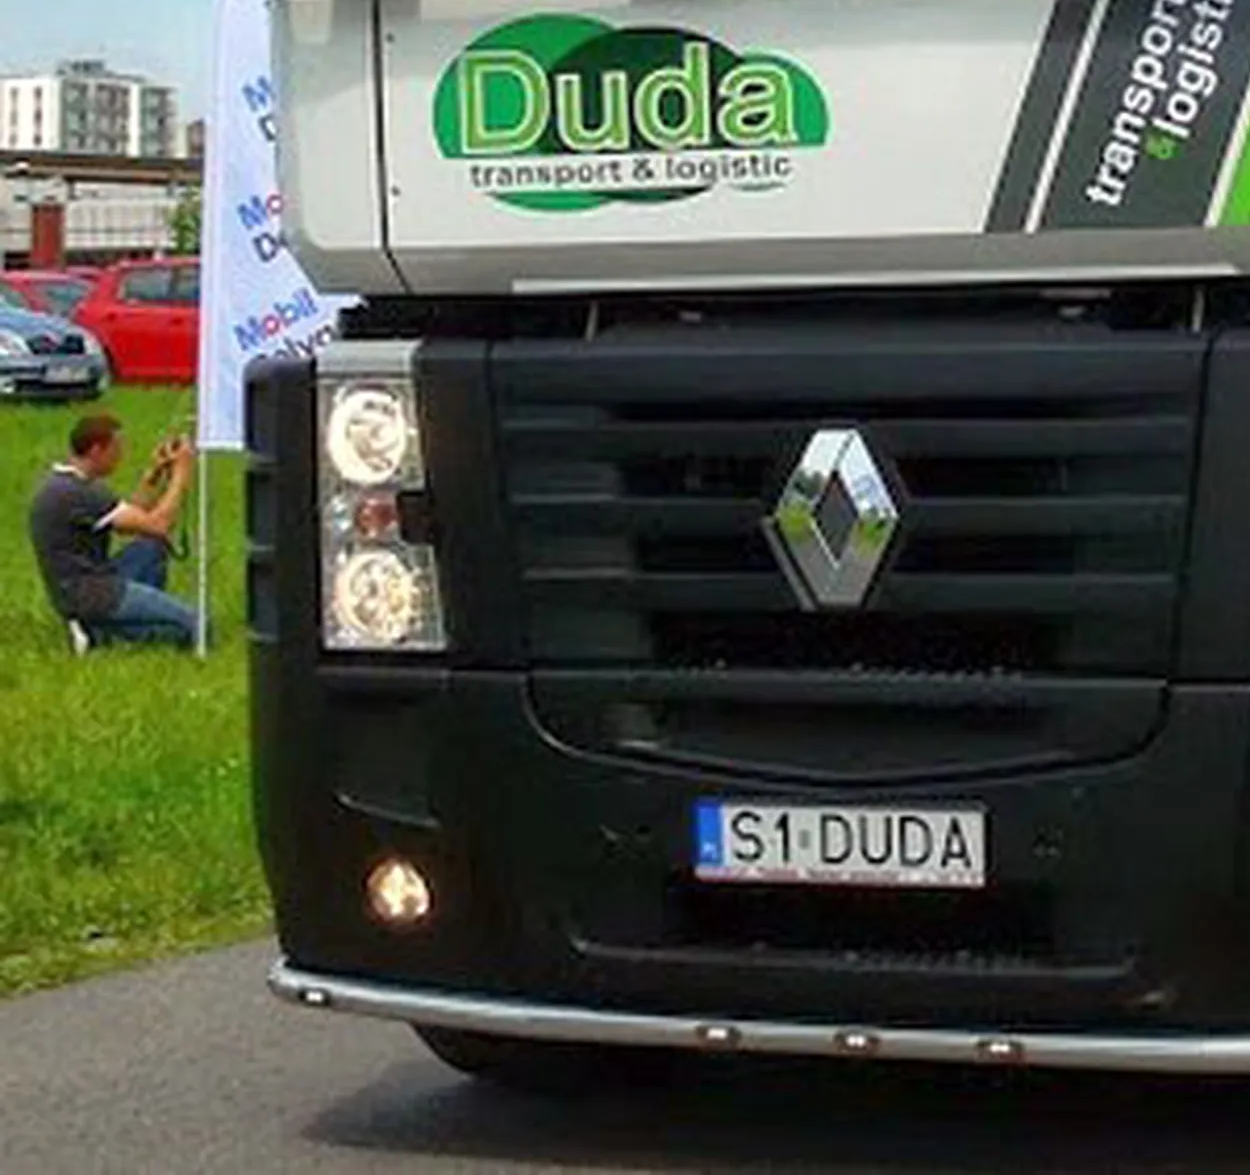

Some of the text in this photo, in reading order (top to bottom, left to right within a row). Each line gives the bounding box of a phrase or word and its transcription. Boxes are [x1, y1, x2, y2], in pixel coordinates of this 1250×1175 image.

[459, 41, 798, 155] Duda
[470, 154, 793, 189] transport & logistic
[234, 286, 318, 351] Mobil
[730, 812, 972, 869] S1 DUDA
